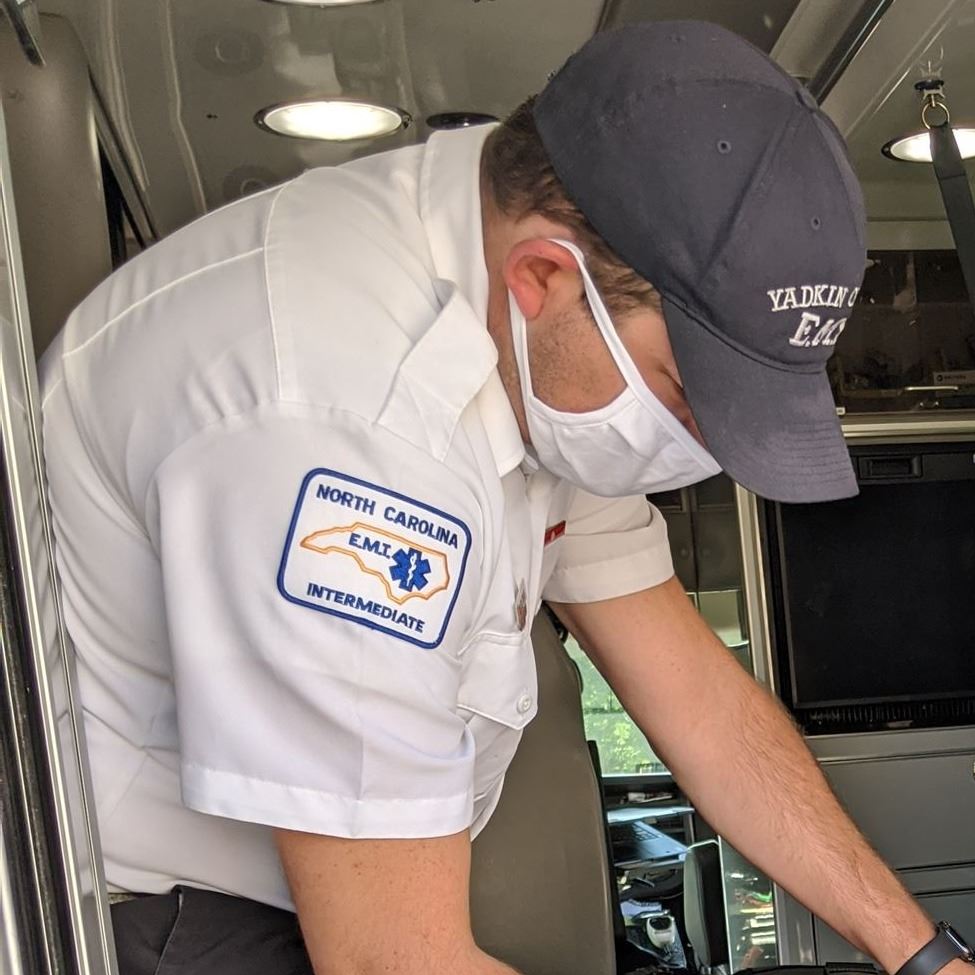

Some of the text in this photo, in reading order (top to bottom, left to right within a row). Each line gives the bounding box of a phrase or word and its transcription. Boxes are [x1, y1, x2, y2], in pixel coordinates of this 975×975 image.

[767, 284, 849, 312] YADKIN
[316, 484, 458, 549] NORTH CAROLINA
[307, 582, 426, 633] INTERMEDIATE
